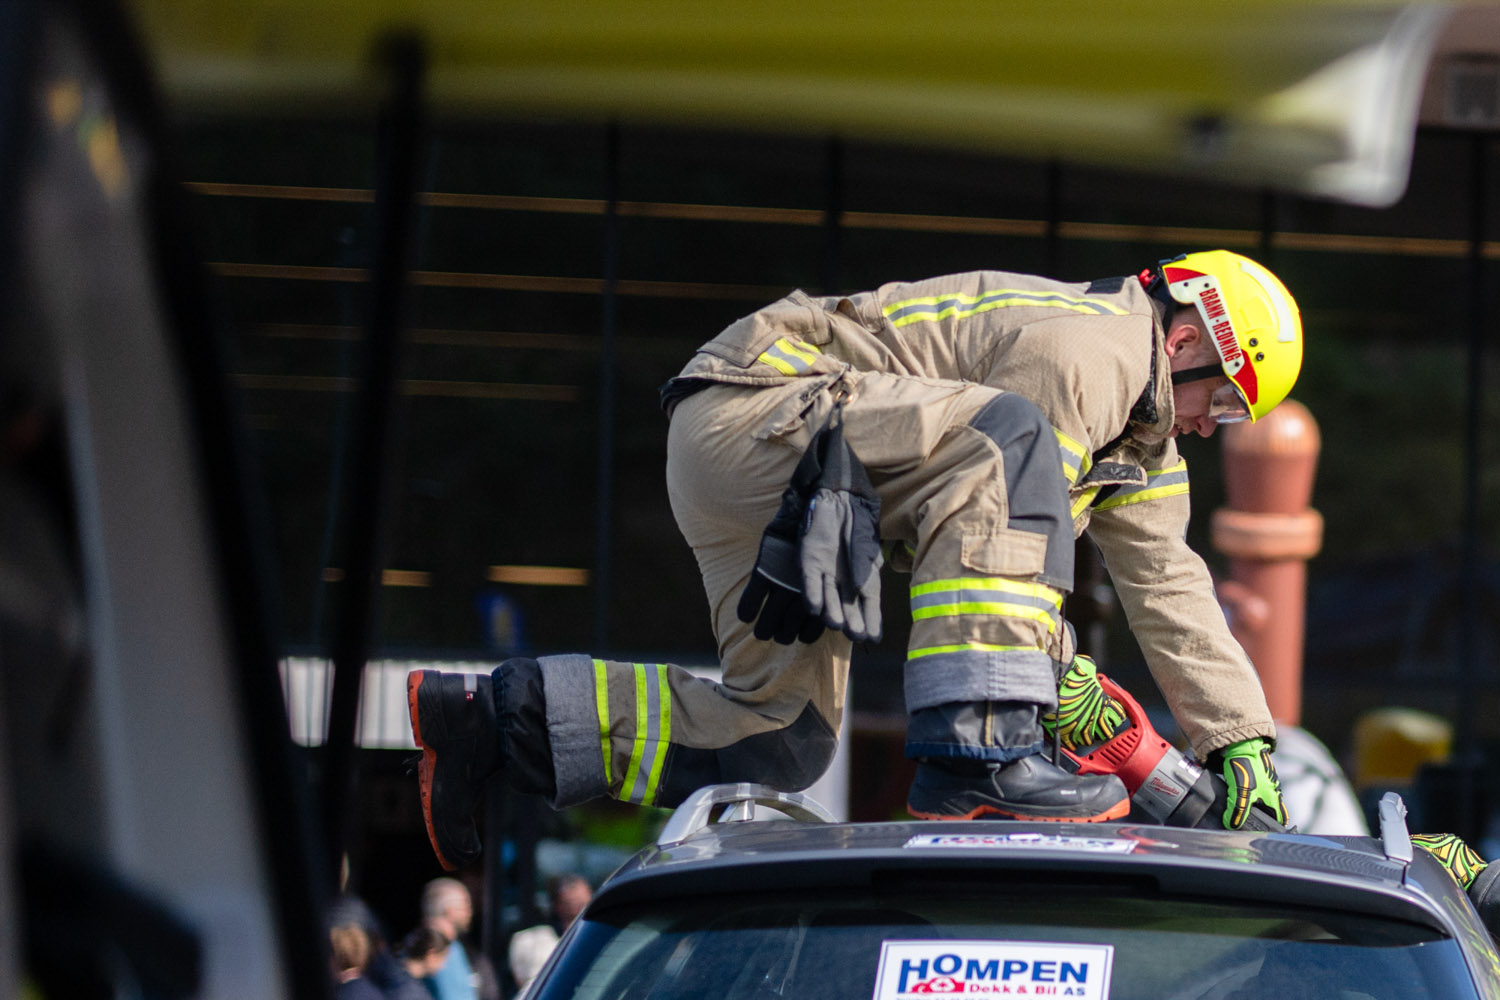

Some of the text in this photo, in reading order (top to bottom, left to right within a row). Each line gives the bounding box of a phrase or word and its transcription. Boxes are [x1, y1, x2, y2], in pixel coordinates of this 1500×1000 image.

[897, 954, 1088, 993] HOMPEN
[969, 984, 1085, 996] Dekk & Bil AS
